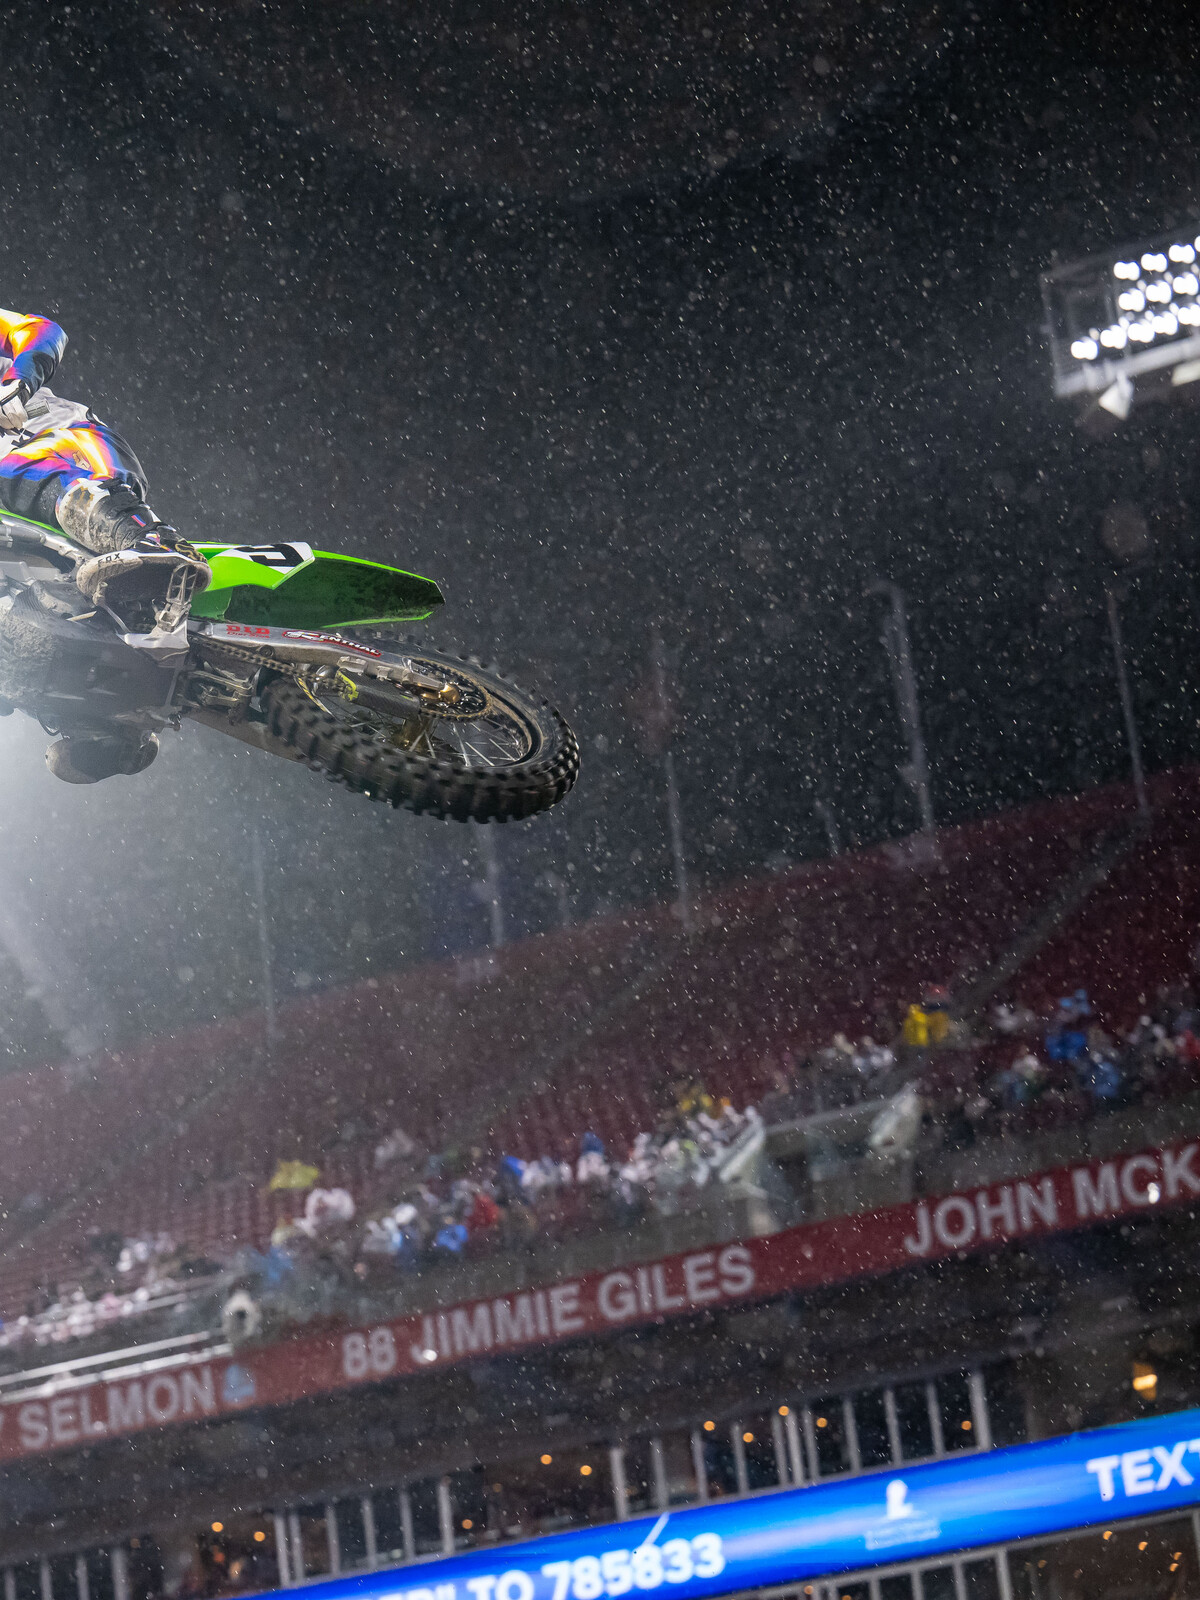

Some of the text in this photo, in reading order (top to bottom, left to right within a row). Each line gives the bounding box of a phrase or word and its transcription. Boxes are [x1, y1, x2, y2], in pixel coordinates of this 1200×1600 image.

[904, 1176, 1058, 1256] JOHN
[342, 1245, 755, 1378] 88 JIMMIE GILES
[20, 1370, 214, 1449] SELMON
[541, 1532, 725, 1600] 785833
